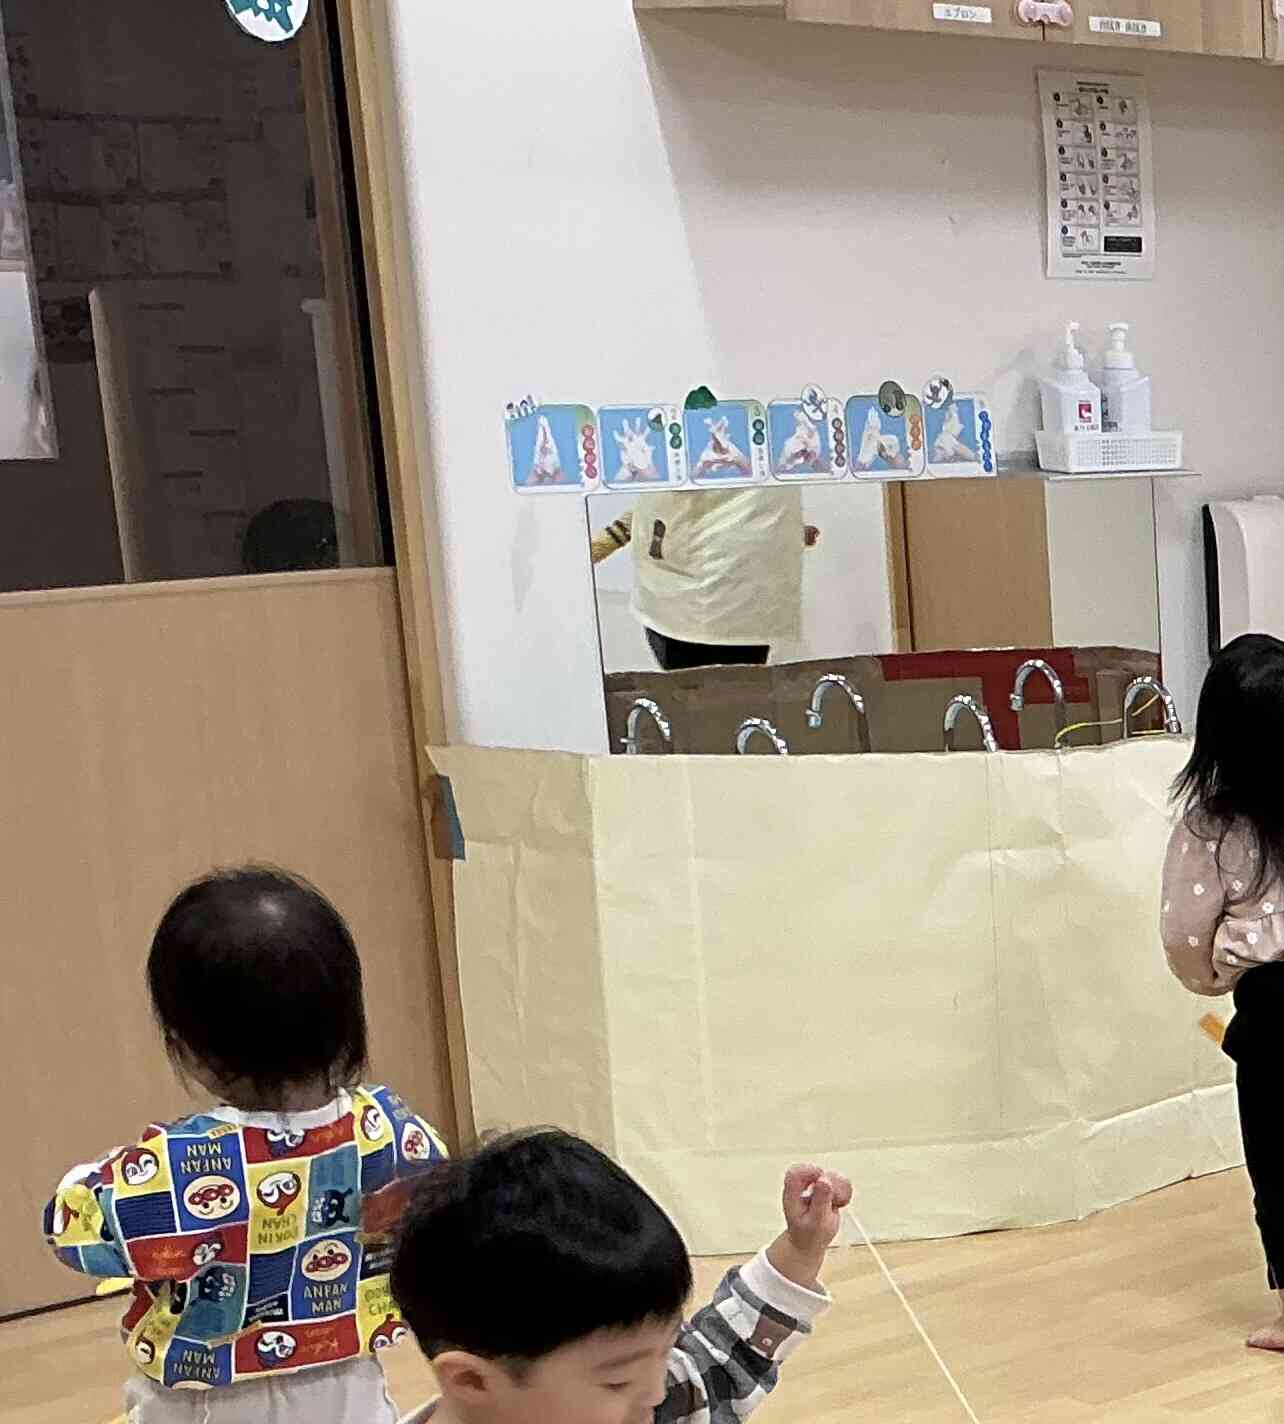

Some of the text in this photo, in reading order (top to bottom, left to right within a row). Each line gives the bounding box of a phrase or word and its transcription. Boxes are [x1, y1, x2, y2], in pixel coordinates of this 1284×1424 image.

[187, 1142, 221, 1157] MAN
[311, 1298, 341, 1313] MAN
[183, 1350, 215, 1364] MAN
